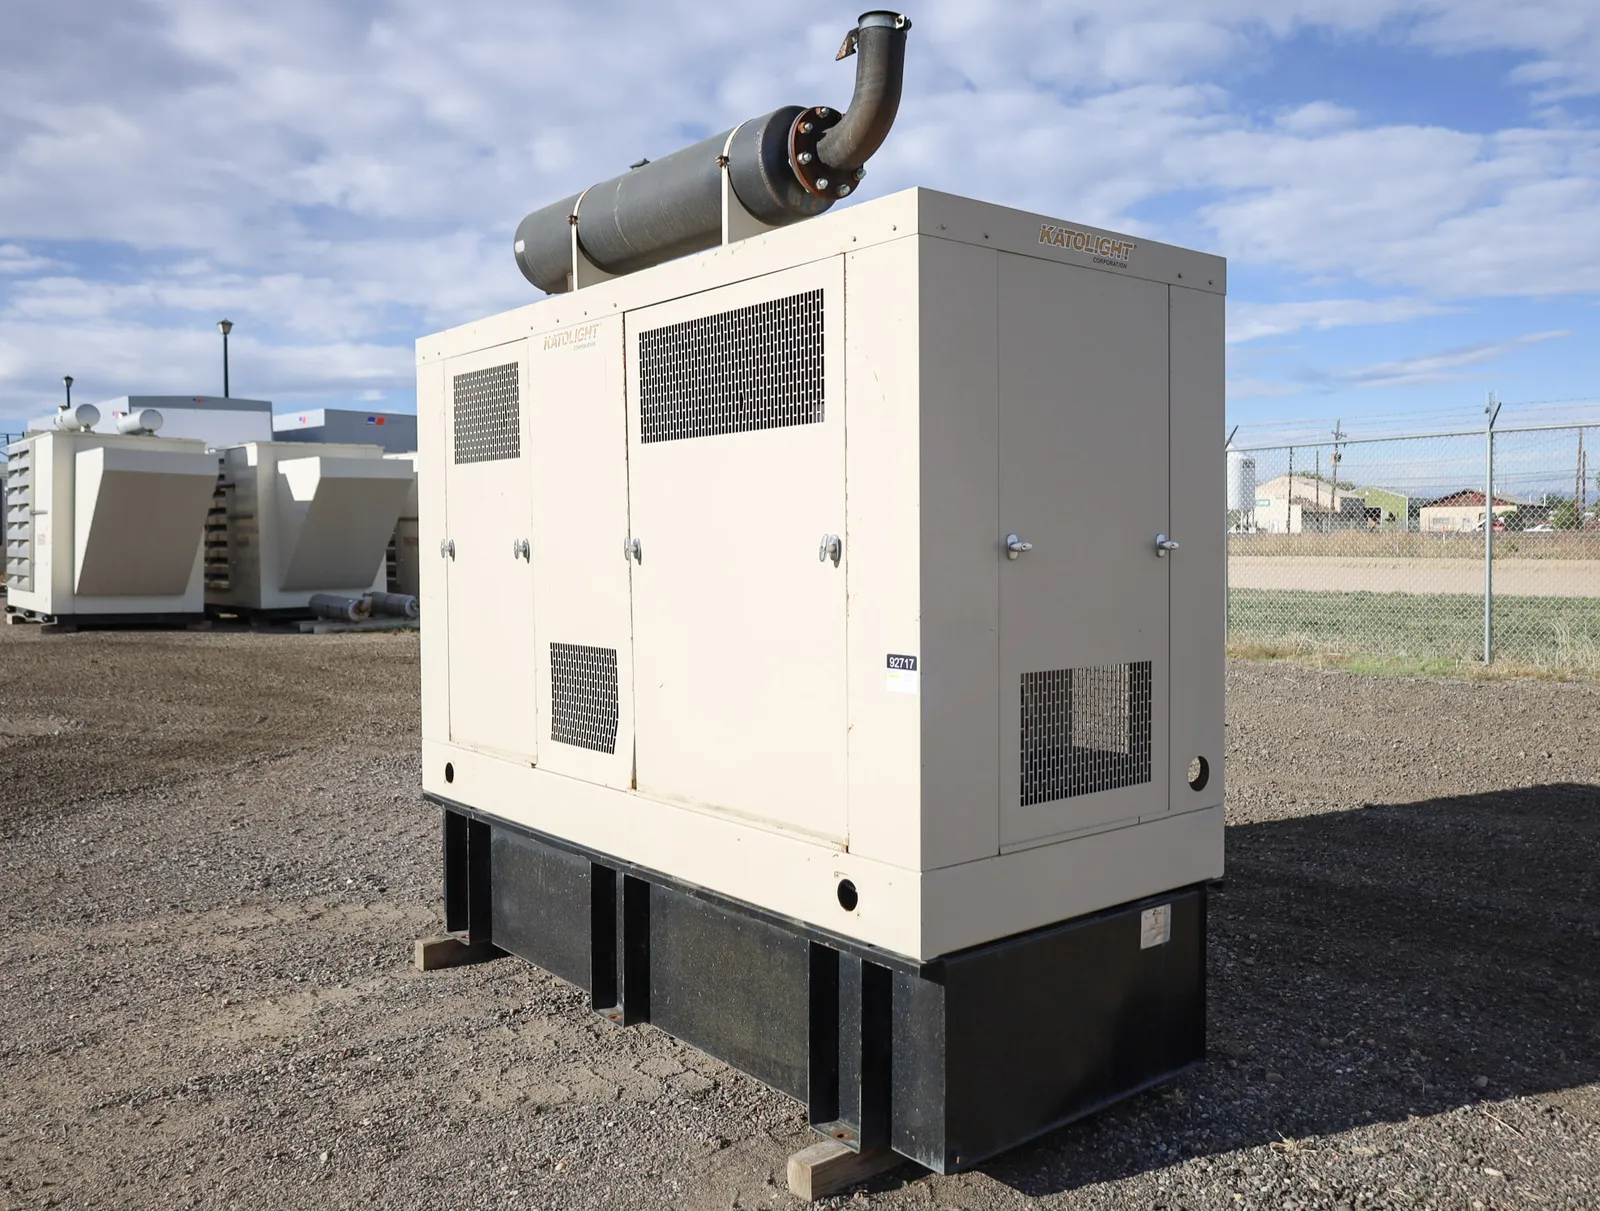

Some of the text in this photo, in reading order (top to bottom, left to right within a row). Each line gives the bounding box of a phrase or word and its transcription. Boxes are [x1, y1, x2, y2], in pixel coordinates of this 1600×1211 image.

[1039, 224, 1134, 261] KATOLIGHT
[1092, 256, 1128, 270] CORPORATION
[543, 323, 600, 351] KATOLIGHT
[889, 656, 915, 669] 92717
